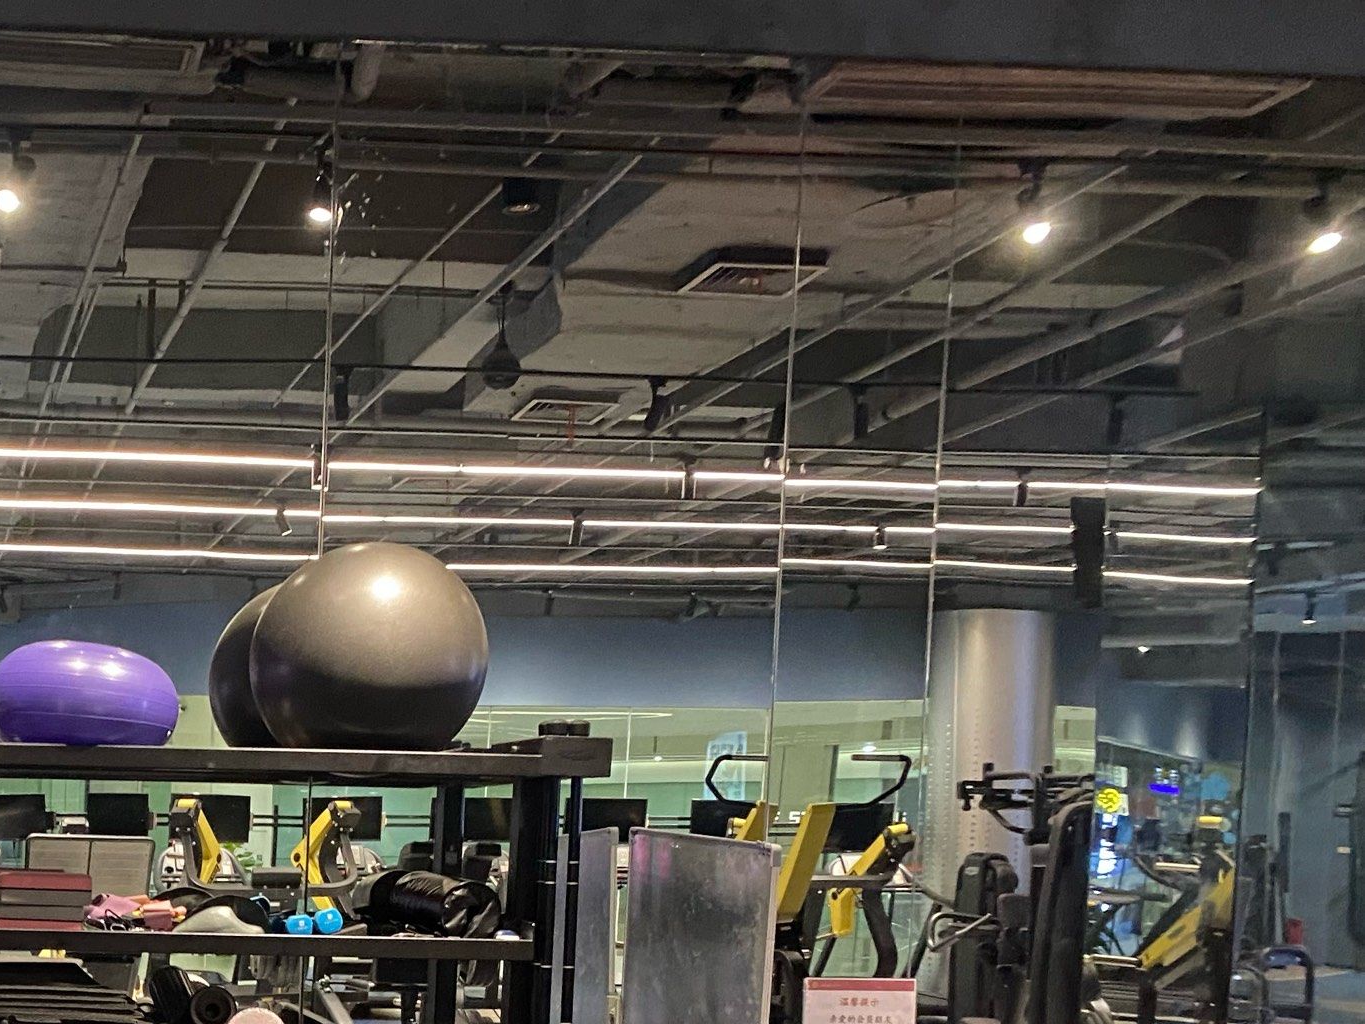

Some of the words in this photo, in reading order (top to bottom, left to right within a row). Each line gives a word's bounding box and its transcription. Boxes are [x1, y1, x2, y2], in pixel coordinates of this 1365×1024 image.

[839, 997, 880, 1007] 温馨提示
[828, 1014, 894, 1024] 亲爱的会员朋友
